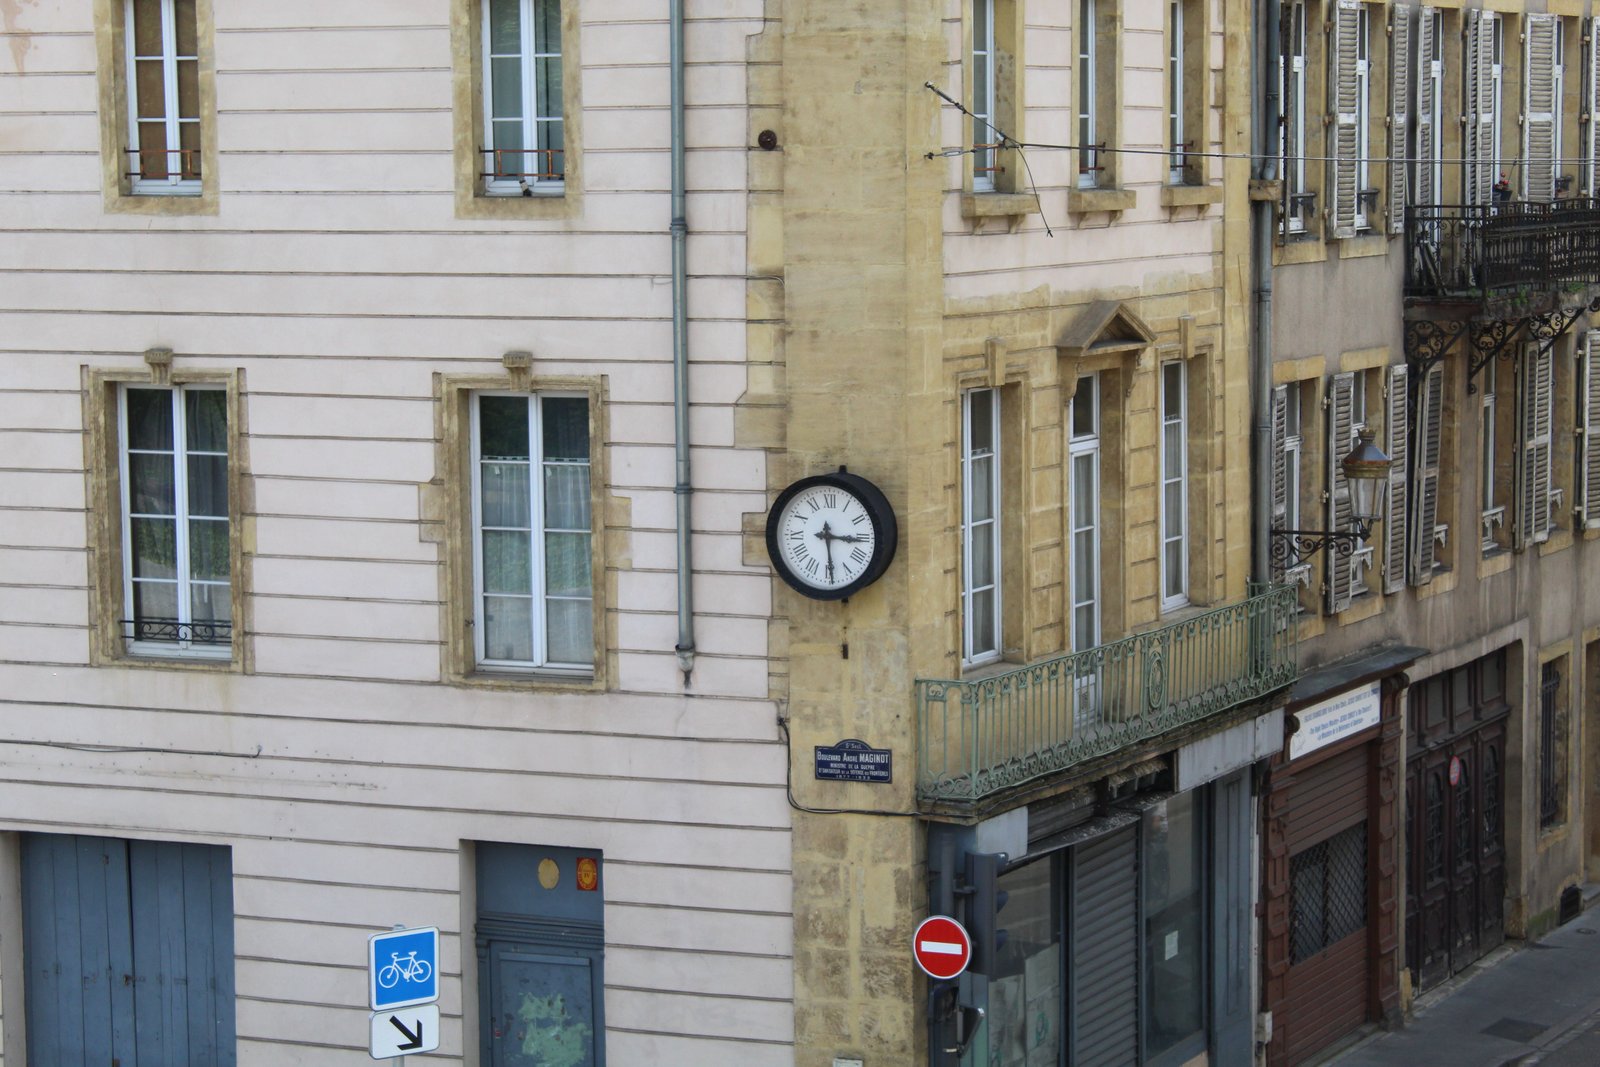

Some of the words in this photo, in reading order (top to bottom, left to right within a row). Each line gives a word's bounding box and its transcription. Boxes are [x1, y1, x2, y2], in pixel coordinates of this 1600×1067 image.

[806, 496, 820, 513] XI
[824, 494, 836, 508] XII
[794, 512, 808, 524] X
[852, 514, 866, 526] II
[859, 753, 889, 763] MAGINOT
